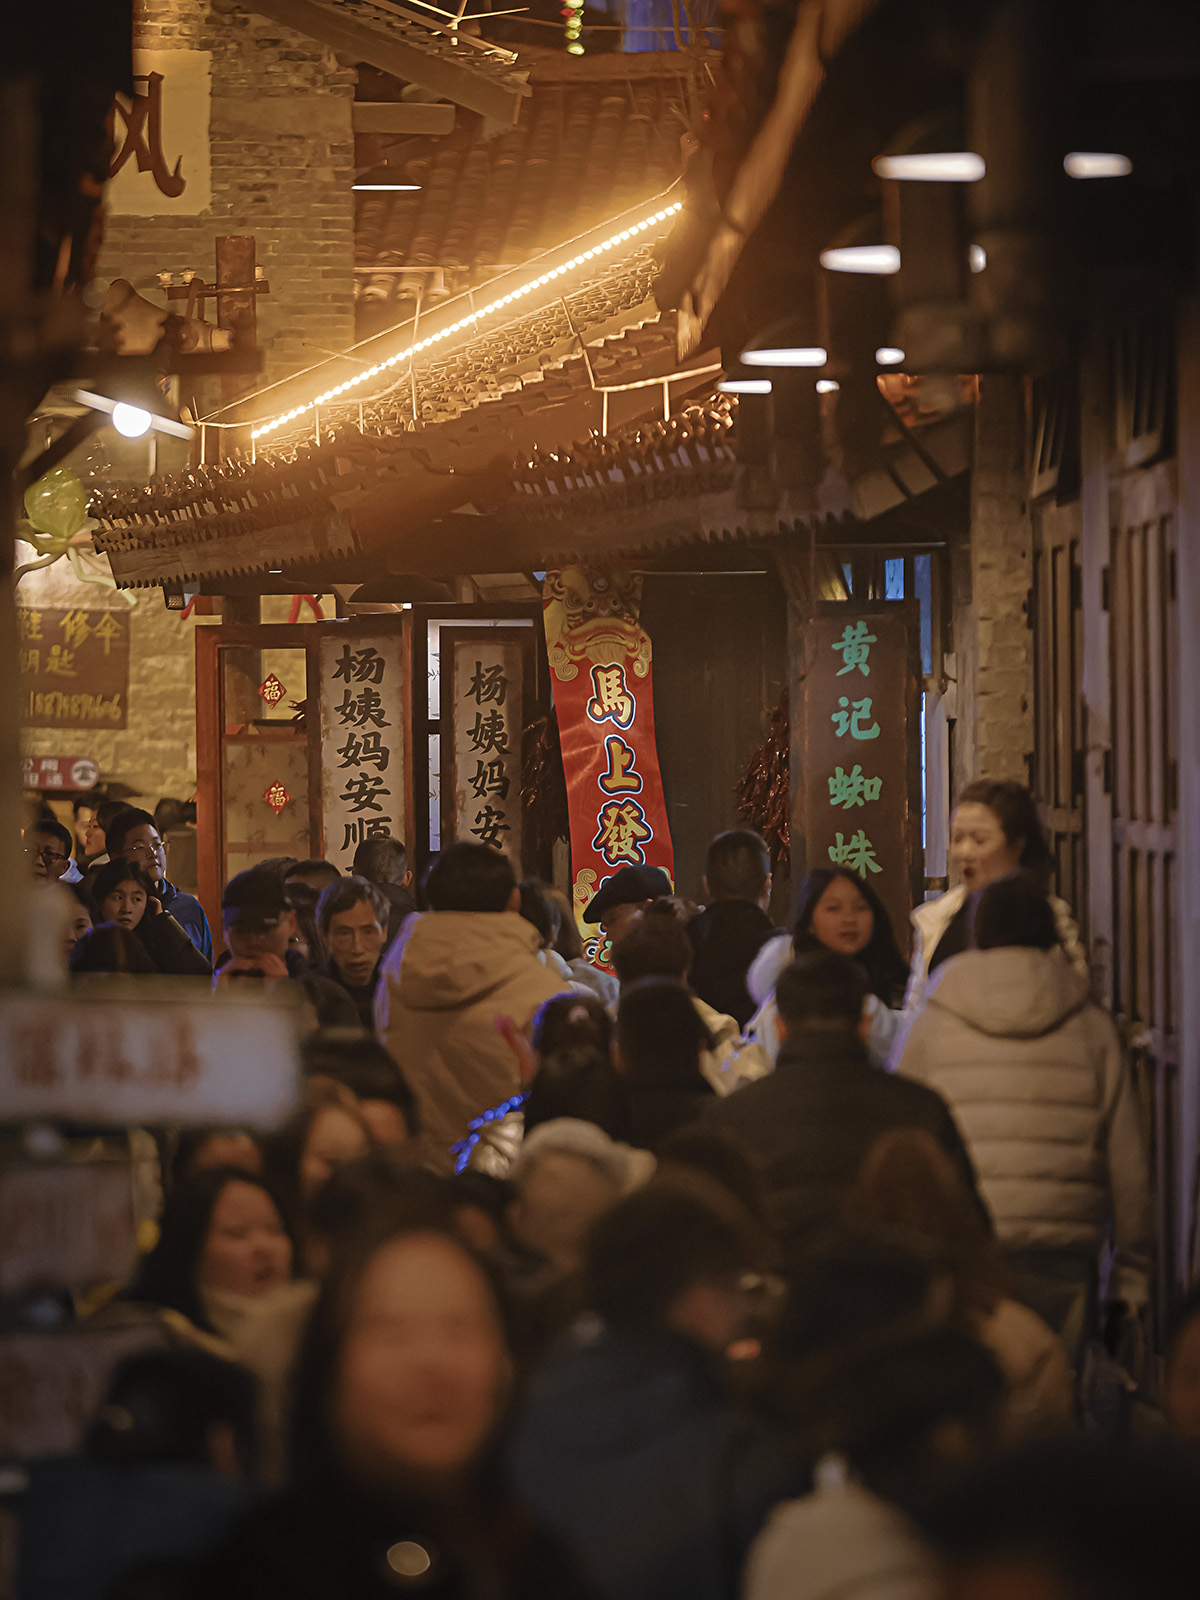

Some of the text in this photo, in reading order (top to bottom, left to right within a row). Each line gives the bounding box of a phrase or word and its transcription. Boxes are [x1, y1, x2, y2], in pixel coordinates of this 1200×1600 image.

[59, 609, 124, 655] 修伞
[264, 681, 280, 700] 福
[269, 787, 286, 806] 福
[332, 644, 392, 872] 杨姨妈安顺
[464, 661, 512, 849] 杨姨妈安
[586, 662, 653, 934] 馬上發
[828, 621, 883, 879] 黄记蜘蛛
